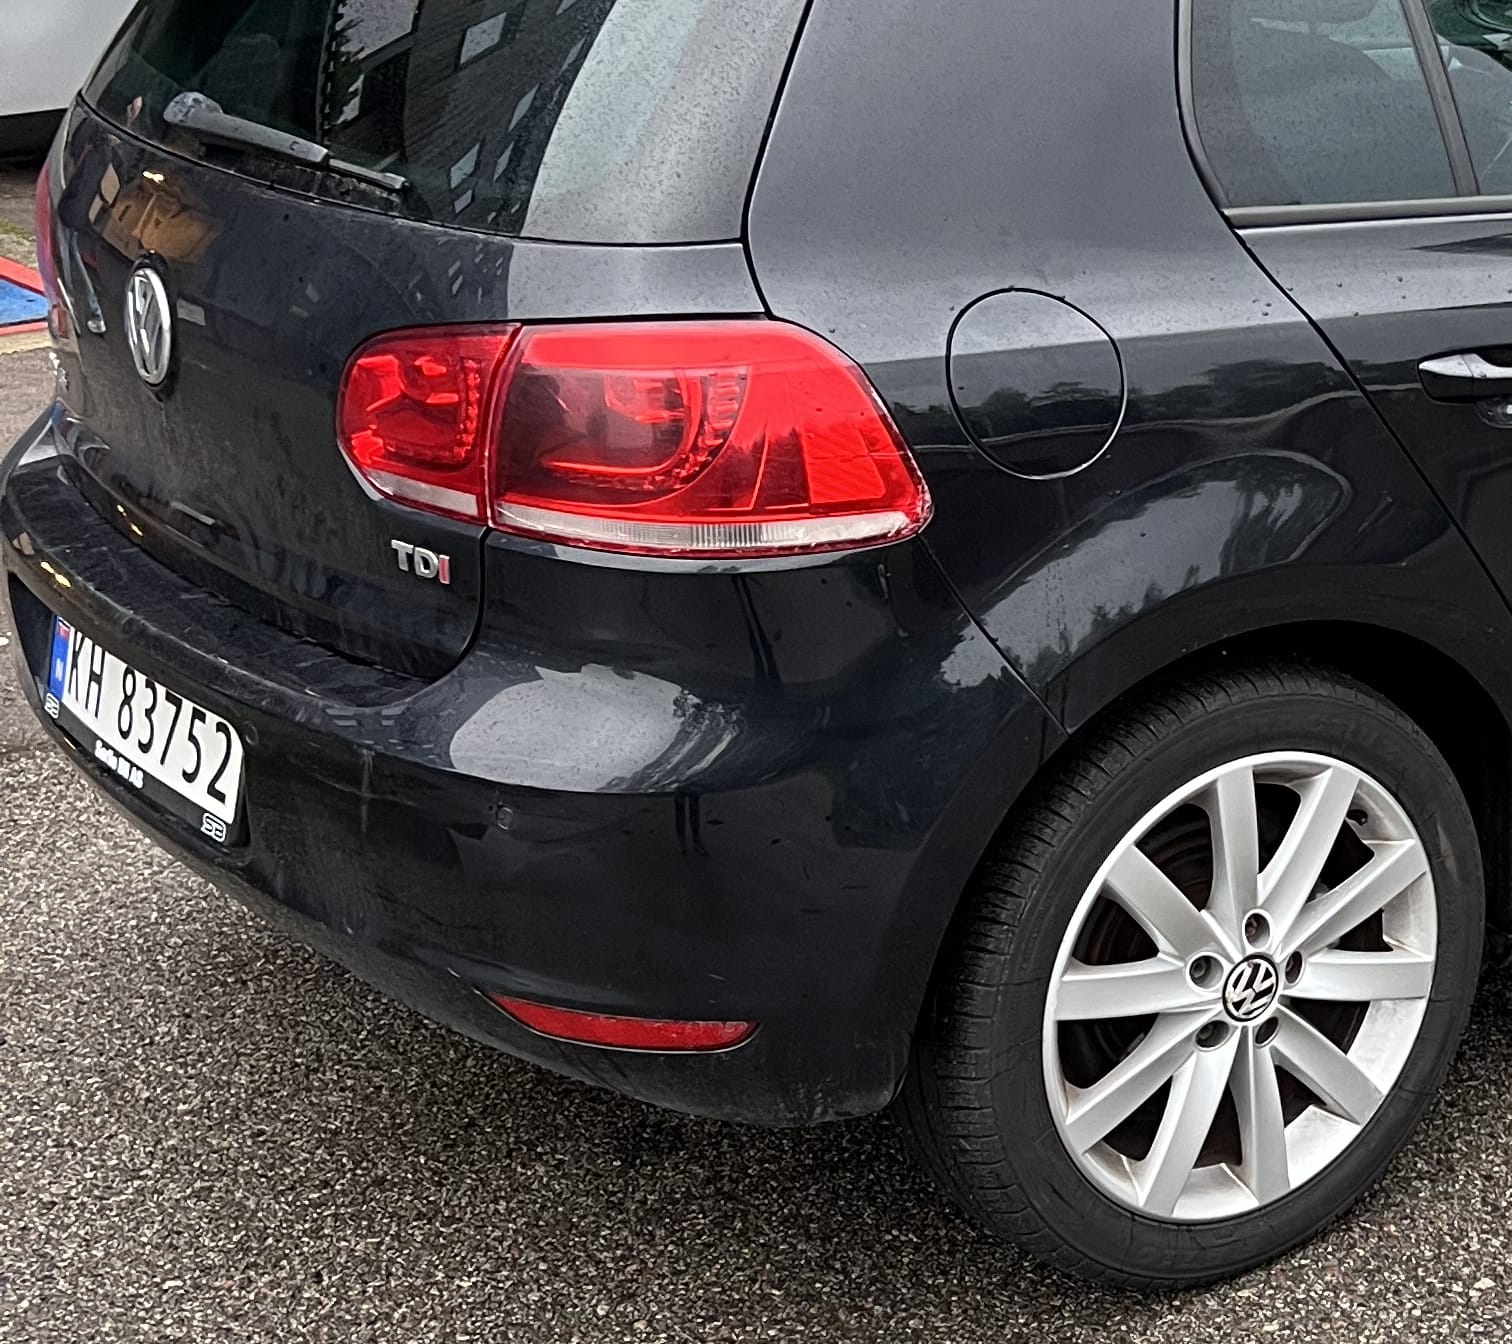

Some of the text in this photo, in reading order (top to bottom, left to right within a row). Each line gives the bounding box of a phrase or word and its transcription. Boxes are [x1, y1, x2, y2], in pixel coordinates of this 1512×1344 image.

[391, 539, 450, 585] TDI
[68, 629, 233, 806] KH 83752
